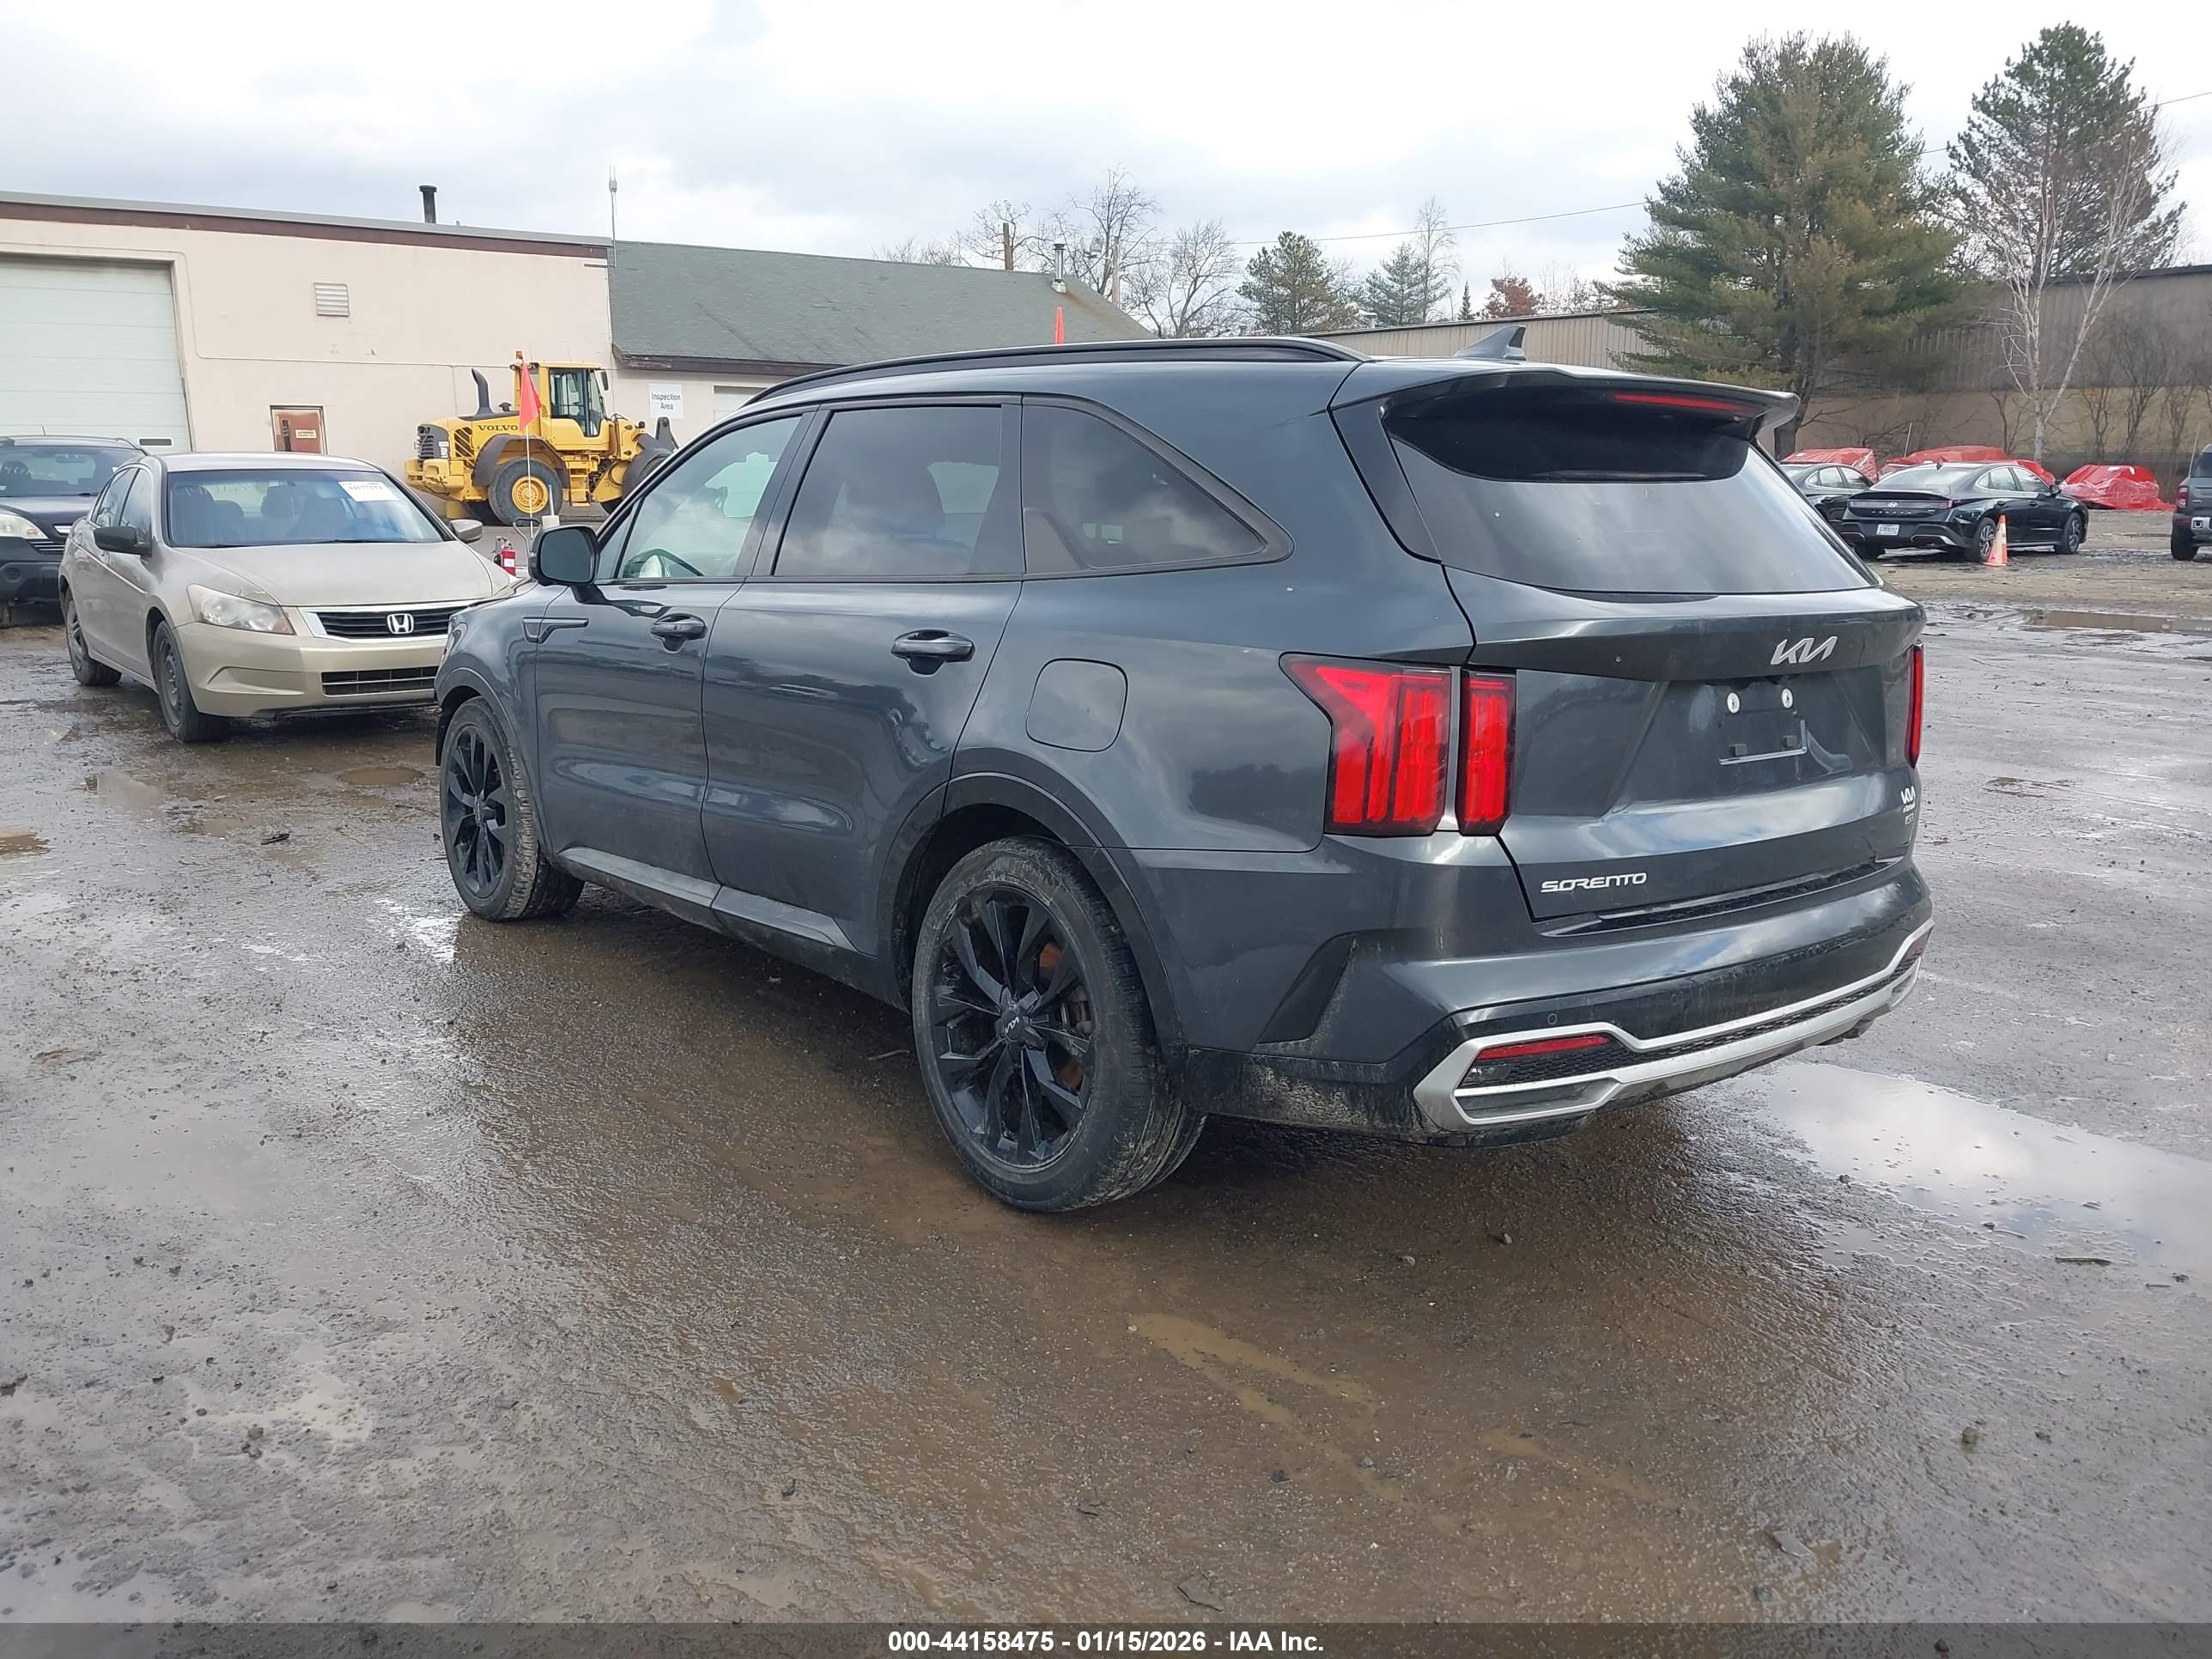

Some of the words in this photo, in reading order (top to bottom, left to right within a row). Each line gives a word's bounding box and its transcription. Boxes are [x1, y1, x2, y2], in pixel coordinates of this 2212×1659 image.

[651, 392, 681, 402] Inspection
[1770, 635, 1838, 665] KIA
[1540, 872, 1648, 893] SORENTO
